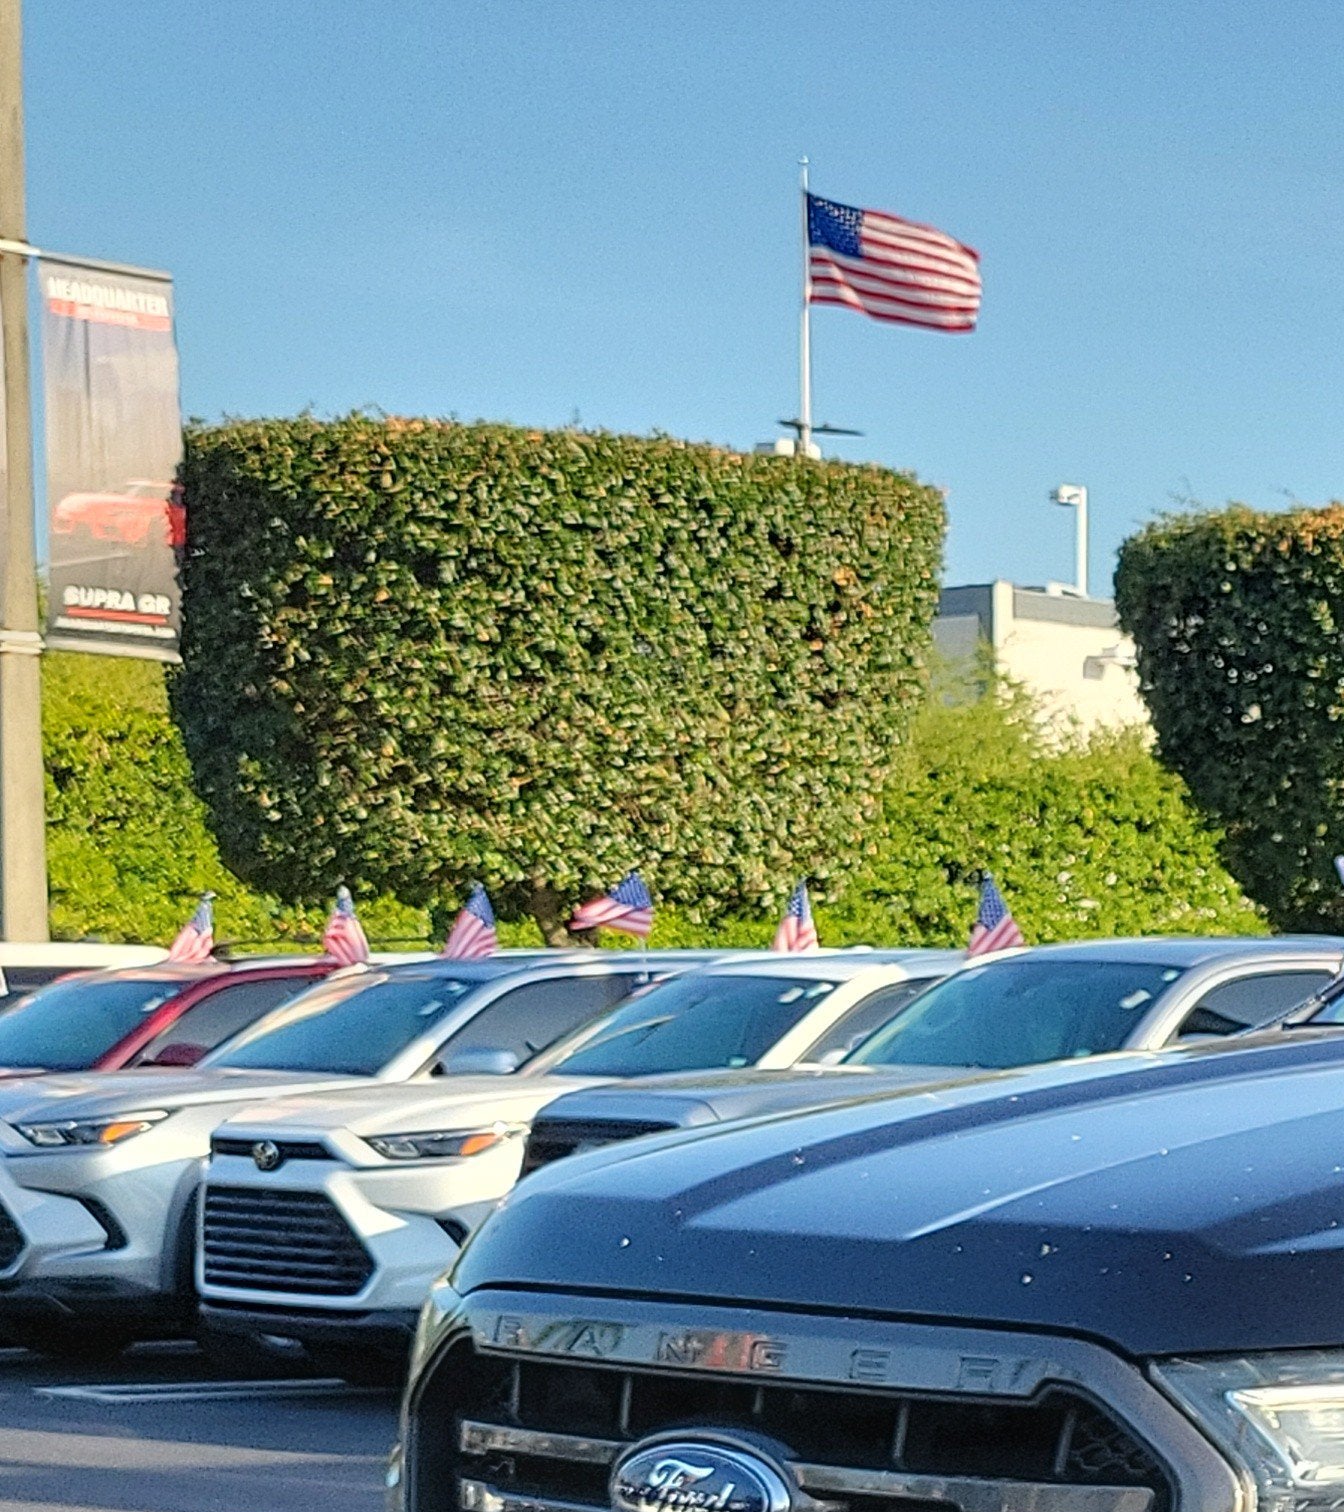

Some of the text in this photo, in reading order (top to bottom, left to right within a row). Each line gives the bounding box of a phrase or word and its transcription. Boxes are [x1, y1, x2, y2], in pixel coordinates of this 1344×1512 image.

[63, 585, 171, 615] SUPRA GR
[490, 1313, 1000, 1390] RANGER
